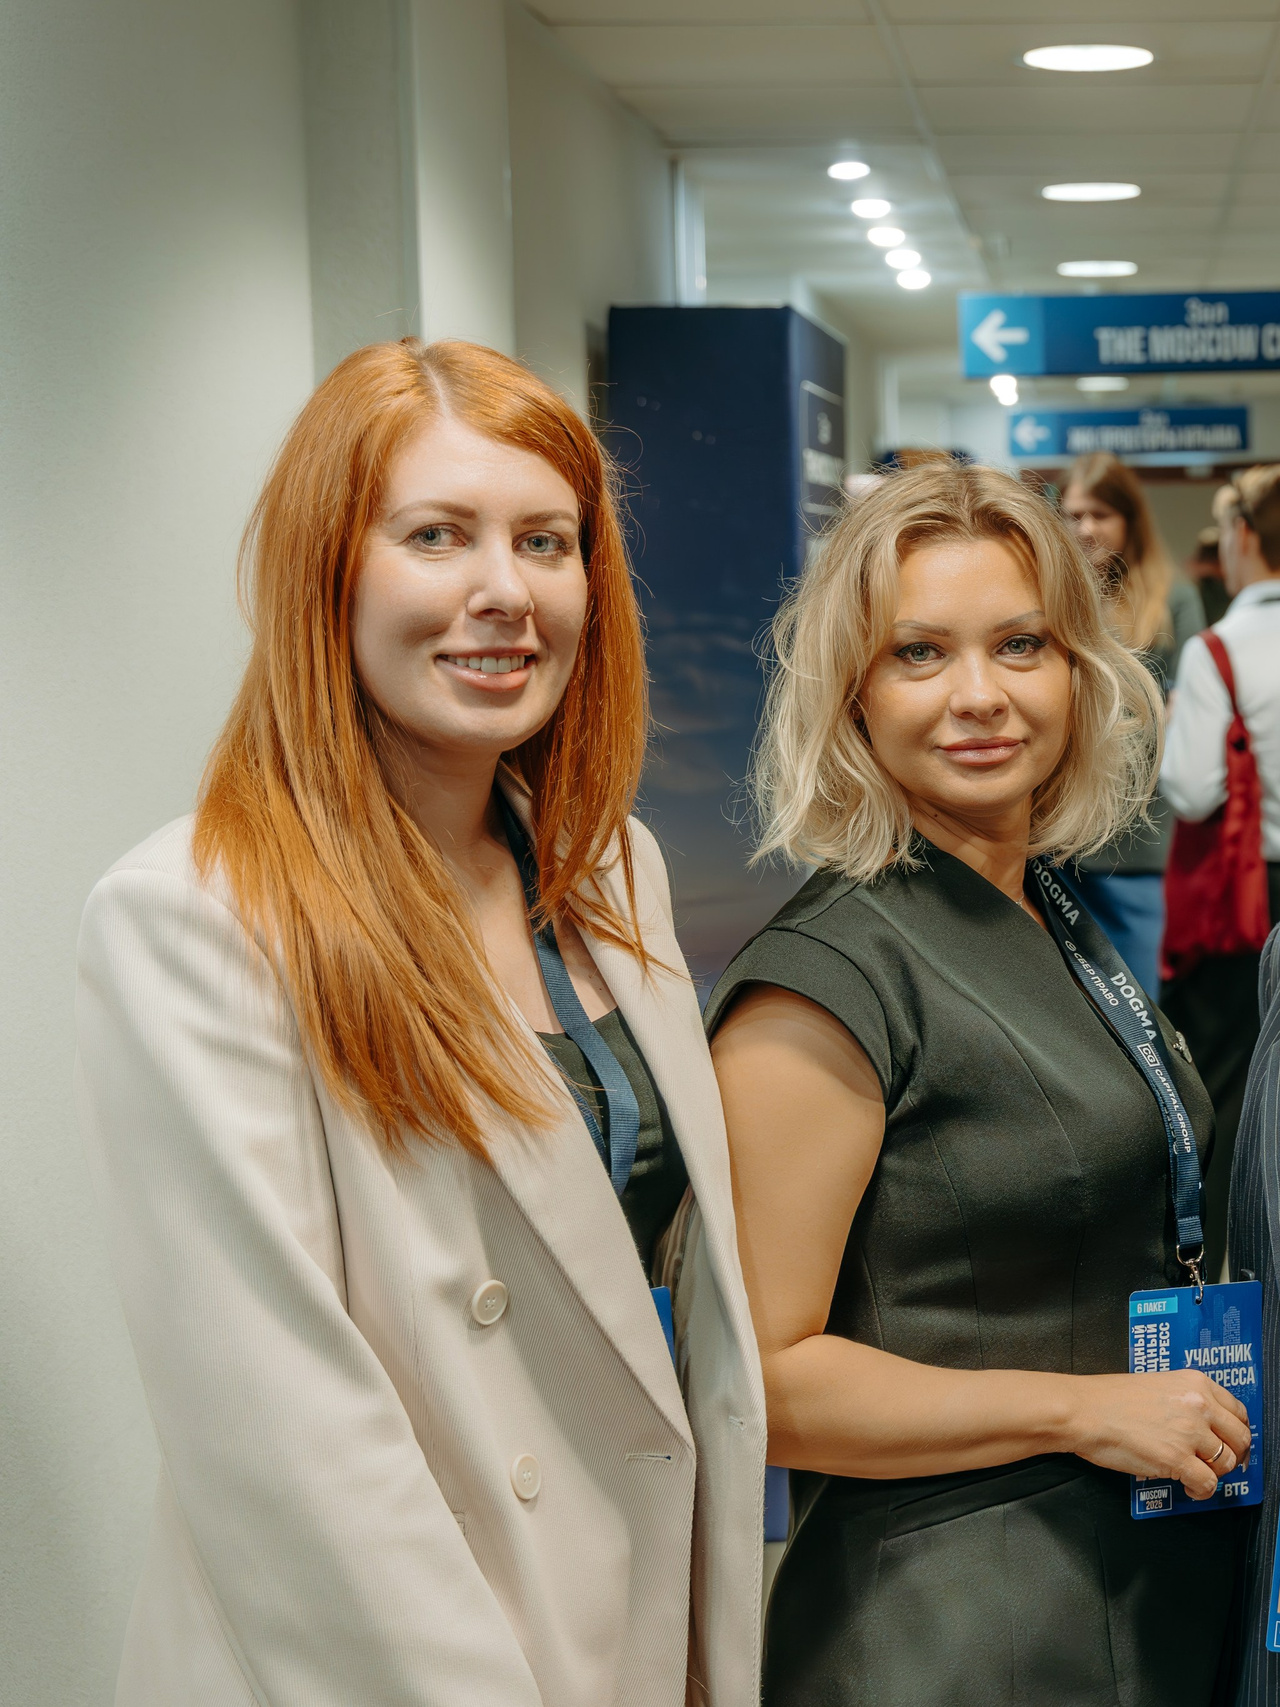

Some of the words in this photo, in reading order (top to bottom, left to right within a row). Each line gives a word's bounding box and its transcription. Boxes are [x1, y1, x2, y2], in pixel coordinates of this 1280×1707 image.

[1094, 326, 1147, 363] THE
[1149, 324, 1258, 362] MOSCOW
[1033, 859, 1080, 925] DOGMA
[1110, 972, 1157, 1042] DOGMA
[1155, 1068, 1179, 1111] CAPITAL
[1177, 1112, 1192, 1153] GROUP
[1143, 1301, 1167, 1313] ПАКЕТ
[1159, 1322, 1170, 1371] НГРЕСС
[1184, 1343, 1253, 1368] УЧАСТНИК
[1204, 1366, 1256, 1387] ГРЕССА
[1139, 1489, 1168, 1501] MOSCOW
[1224, 1481, 1249, 1497] ВТБ
[1145, 1500, 1163, 1510] 2025
